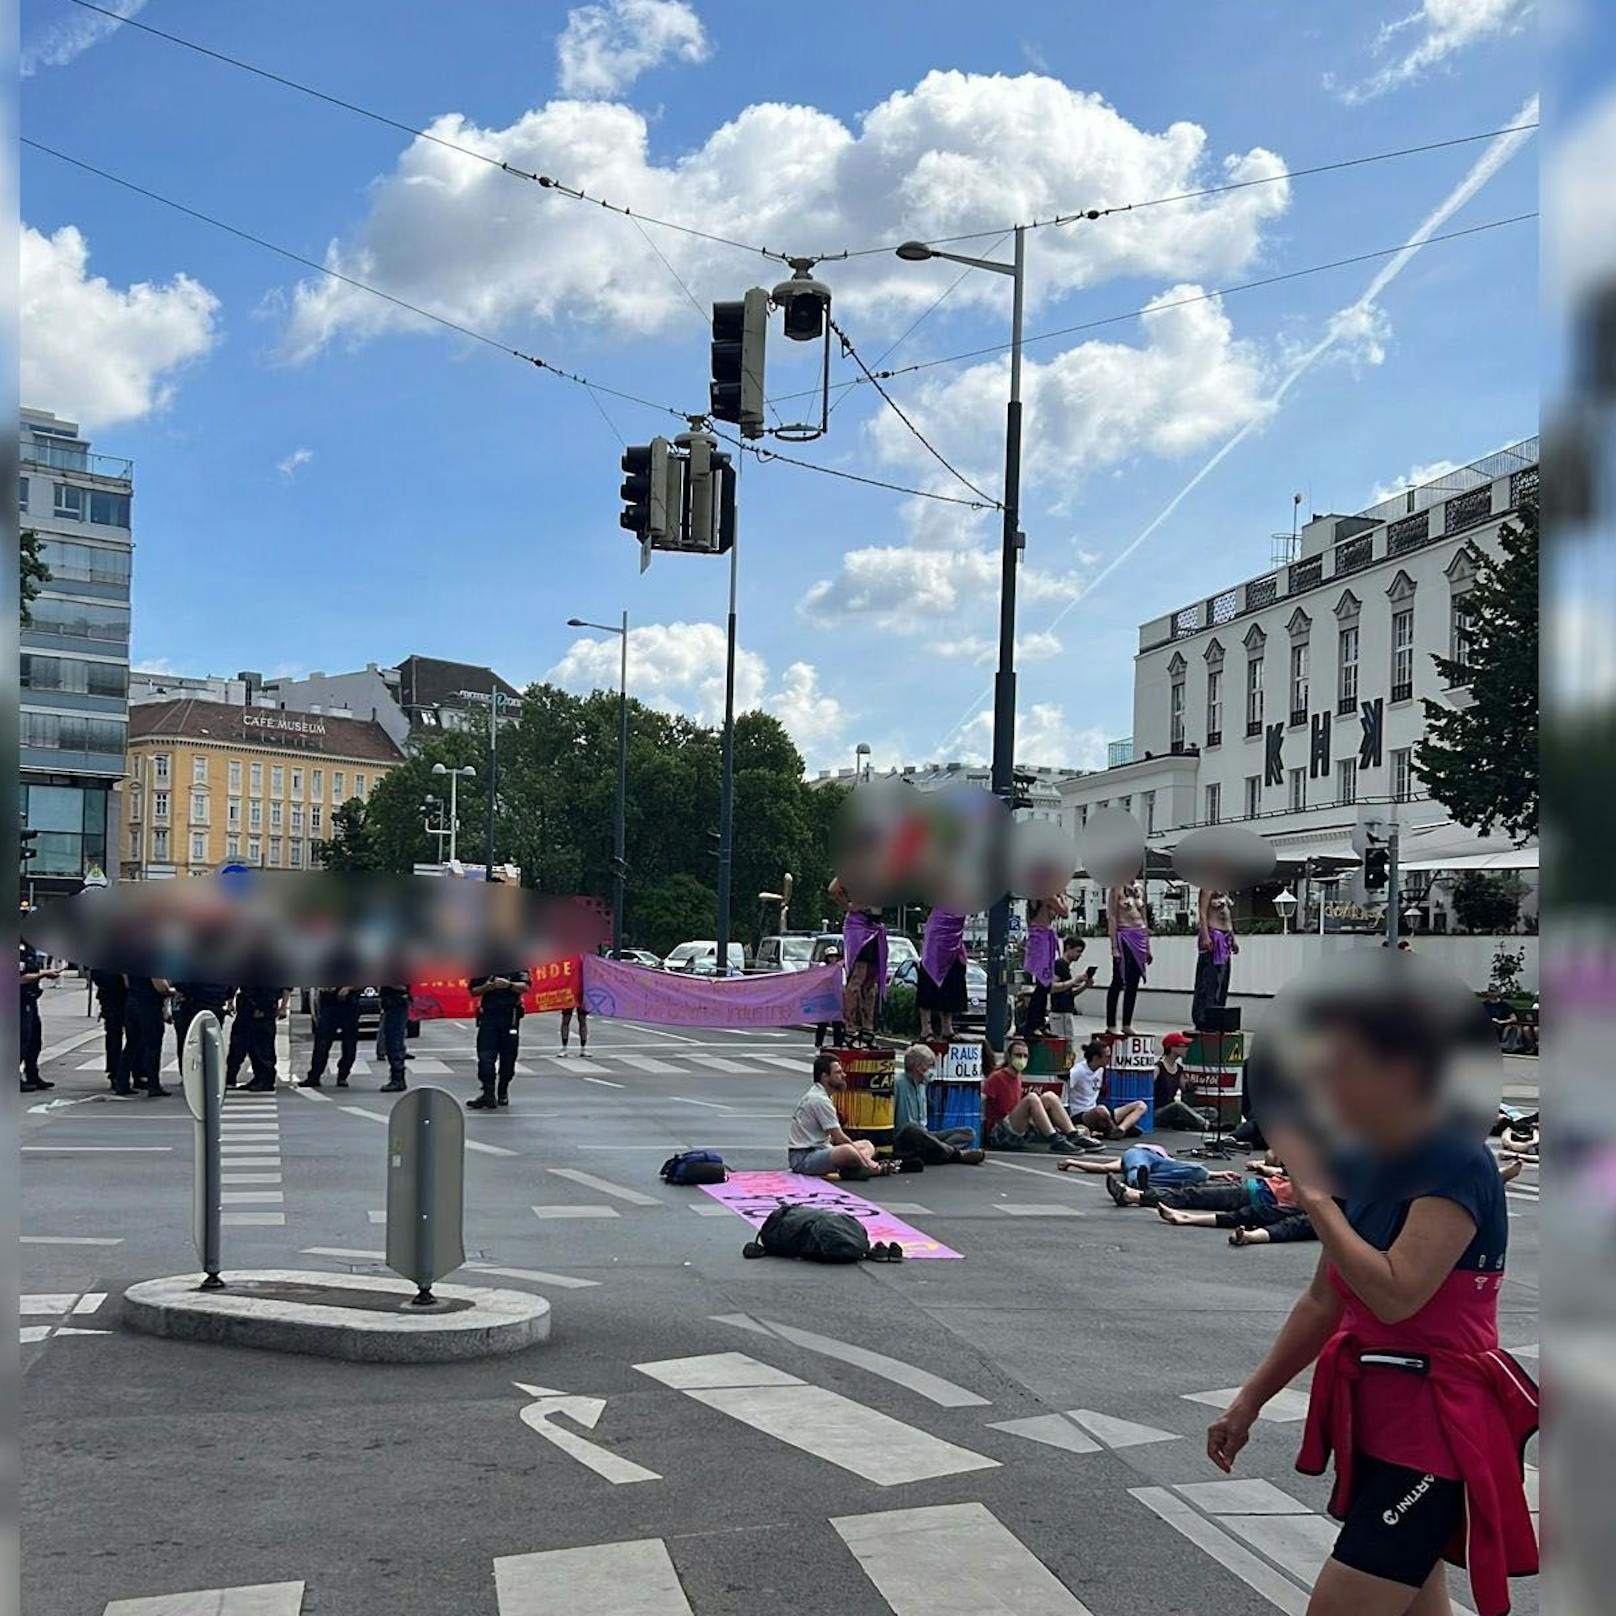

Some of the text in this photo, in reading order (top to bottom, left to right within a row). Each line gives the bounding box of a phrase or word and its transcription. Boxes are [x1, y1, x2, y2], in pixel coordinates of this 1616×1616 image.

[276, 719, 326, 735] MUSEUM
[528, 960, 572, 981] NDE
[950, 1046, 978, 1060] RAUS
[955, 1060, 971, 1077] ÖL
